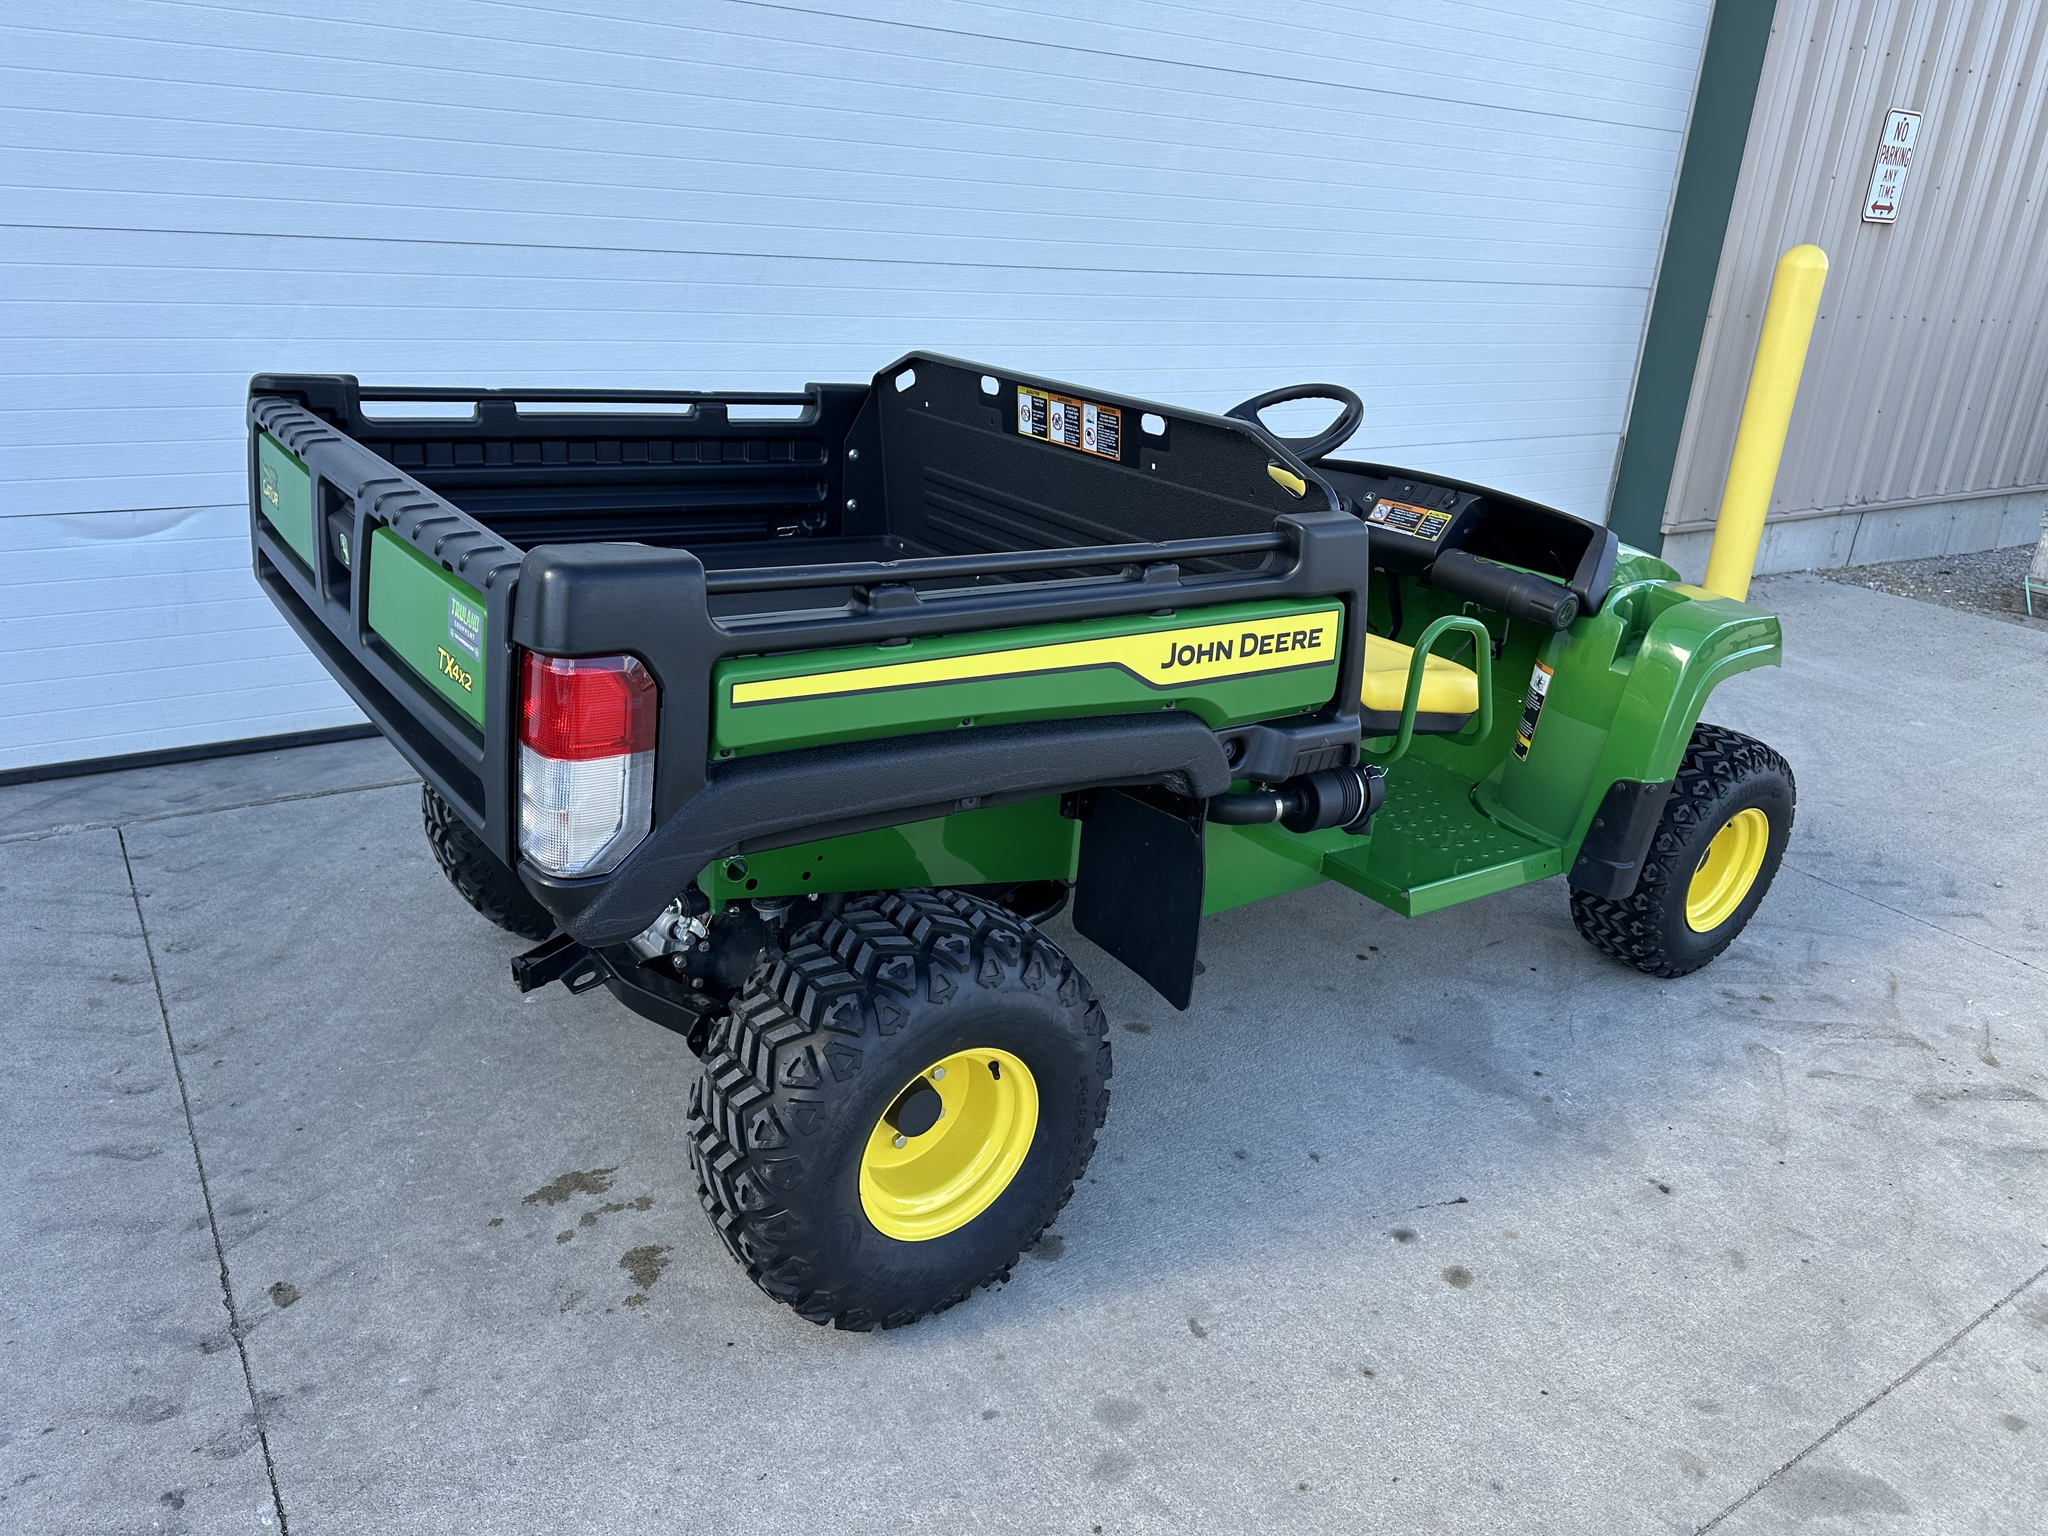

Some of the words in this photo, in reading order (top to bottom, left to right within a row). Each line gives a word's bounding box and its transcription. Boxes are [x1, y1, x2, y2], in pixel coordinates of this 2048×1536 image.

[1893, 121, 1909, 142] NO
[1880, 145, 1911, 167] PARKING
[1883, 169, 1898, 182] ANY
[1878, 184, 1896, 199] TIME
[451, 597, 480, 634] TRULAND
[453, 619, 476, 641] EQUIPMENT
[1160, 639, 1234, 669] JOHN
[1239, 627, 1324, 658] DEERE
